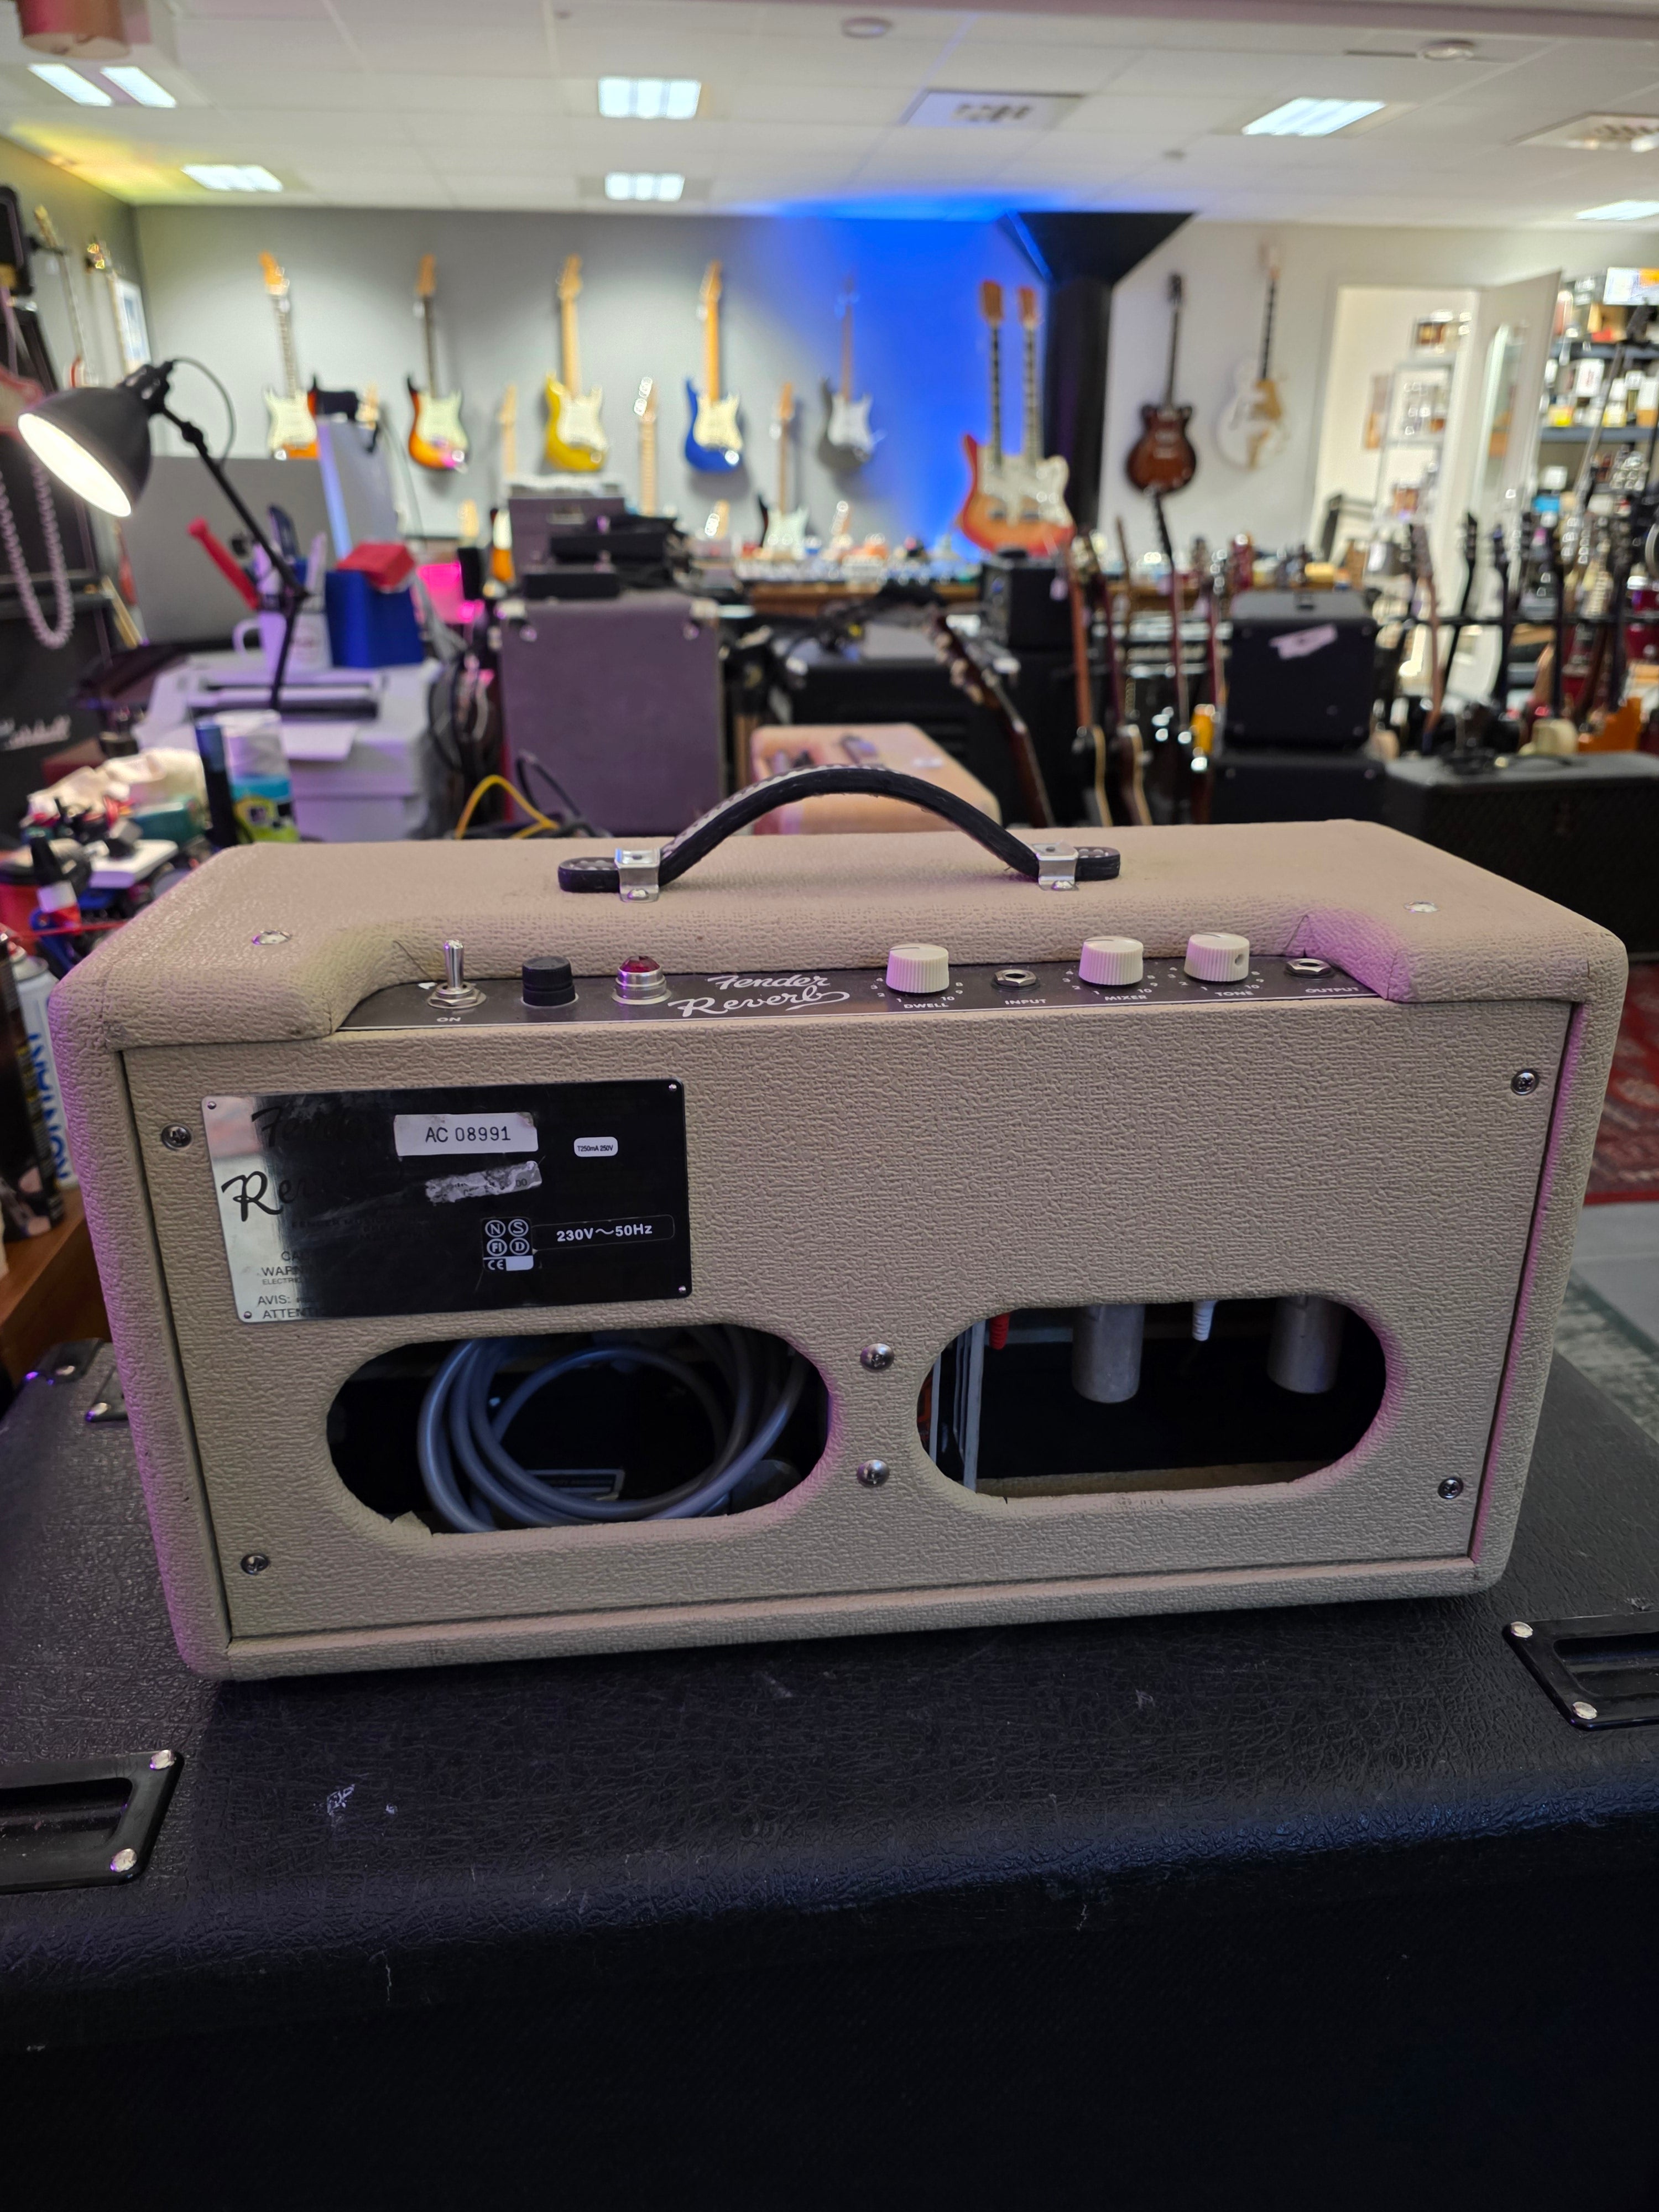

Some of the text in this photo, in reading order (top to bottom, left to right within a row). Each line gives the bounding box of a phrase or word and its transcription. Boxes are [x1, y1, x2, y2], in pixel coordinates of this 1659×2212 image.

[707, 974, 830, 990] Fender
[667, 985, 850, 1017] Reverb
[425, 1125, 511, 1142] AC 08991
[577, 1144, 614, 1152] T250mA 250V
[258, 1295, 291, 1306] AVIS:
